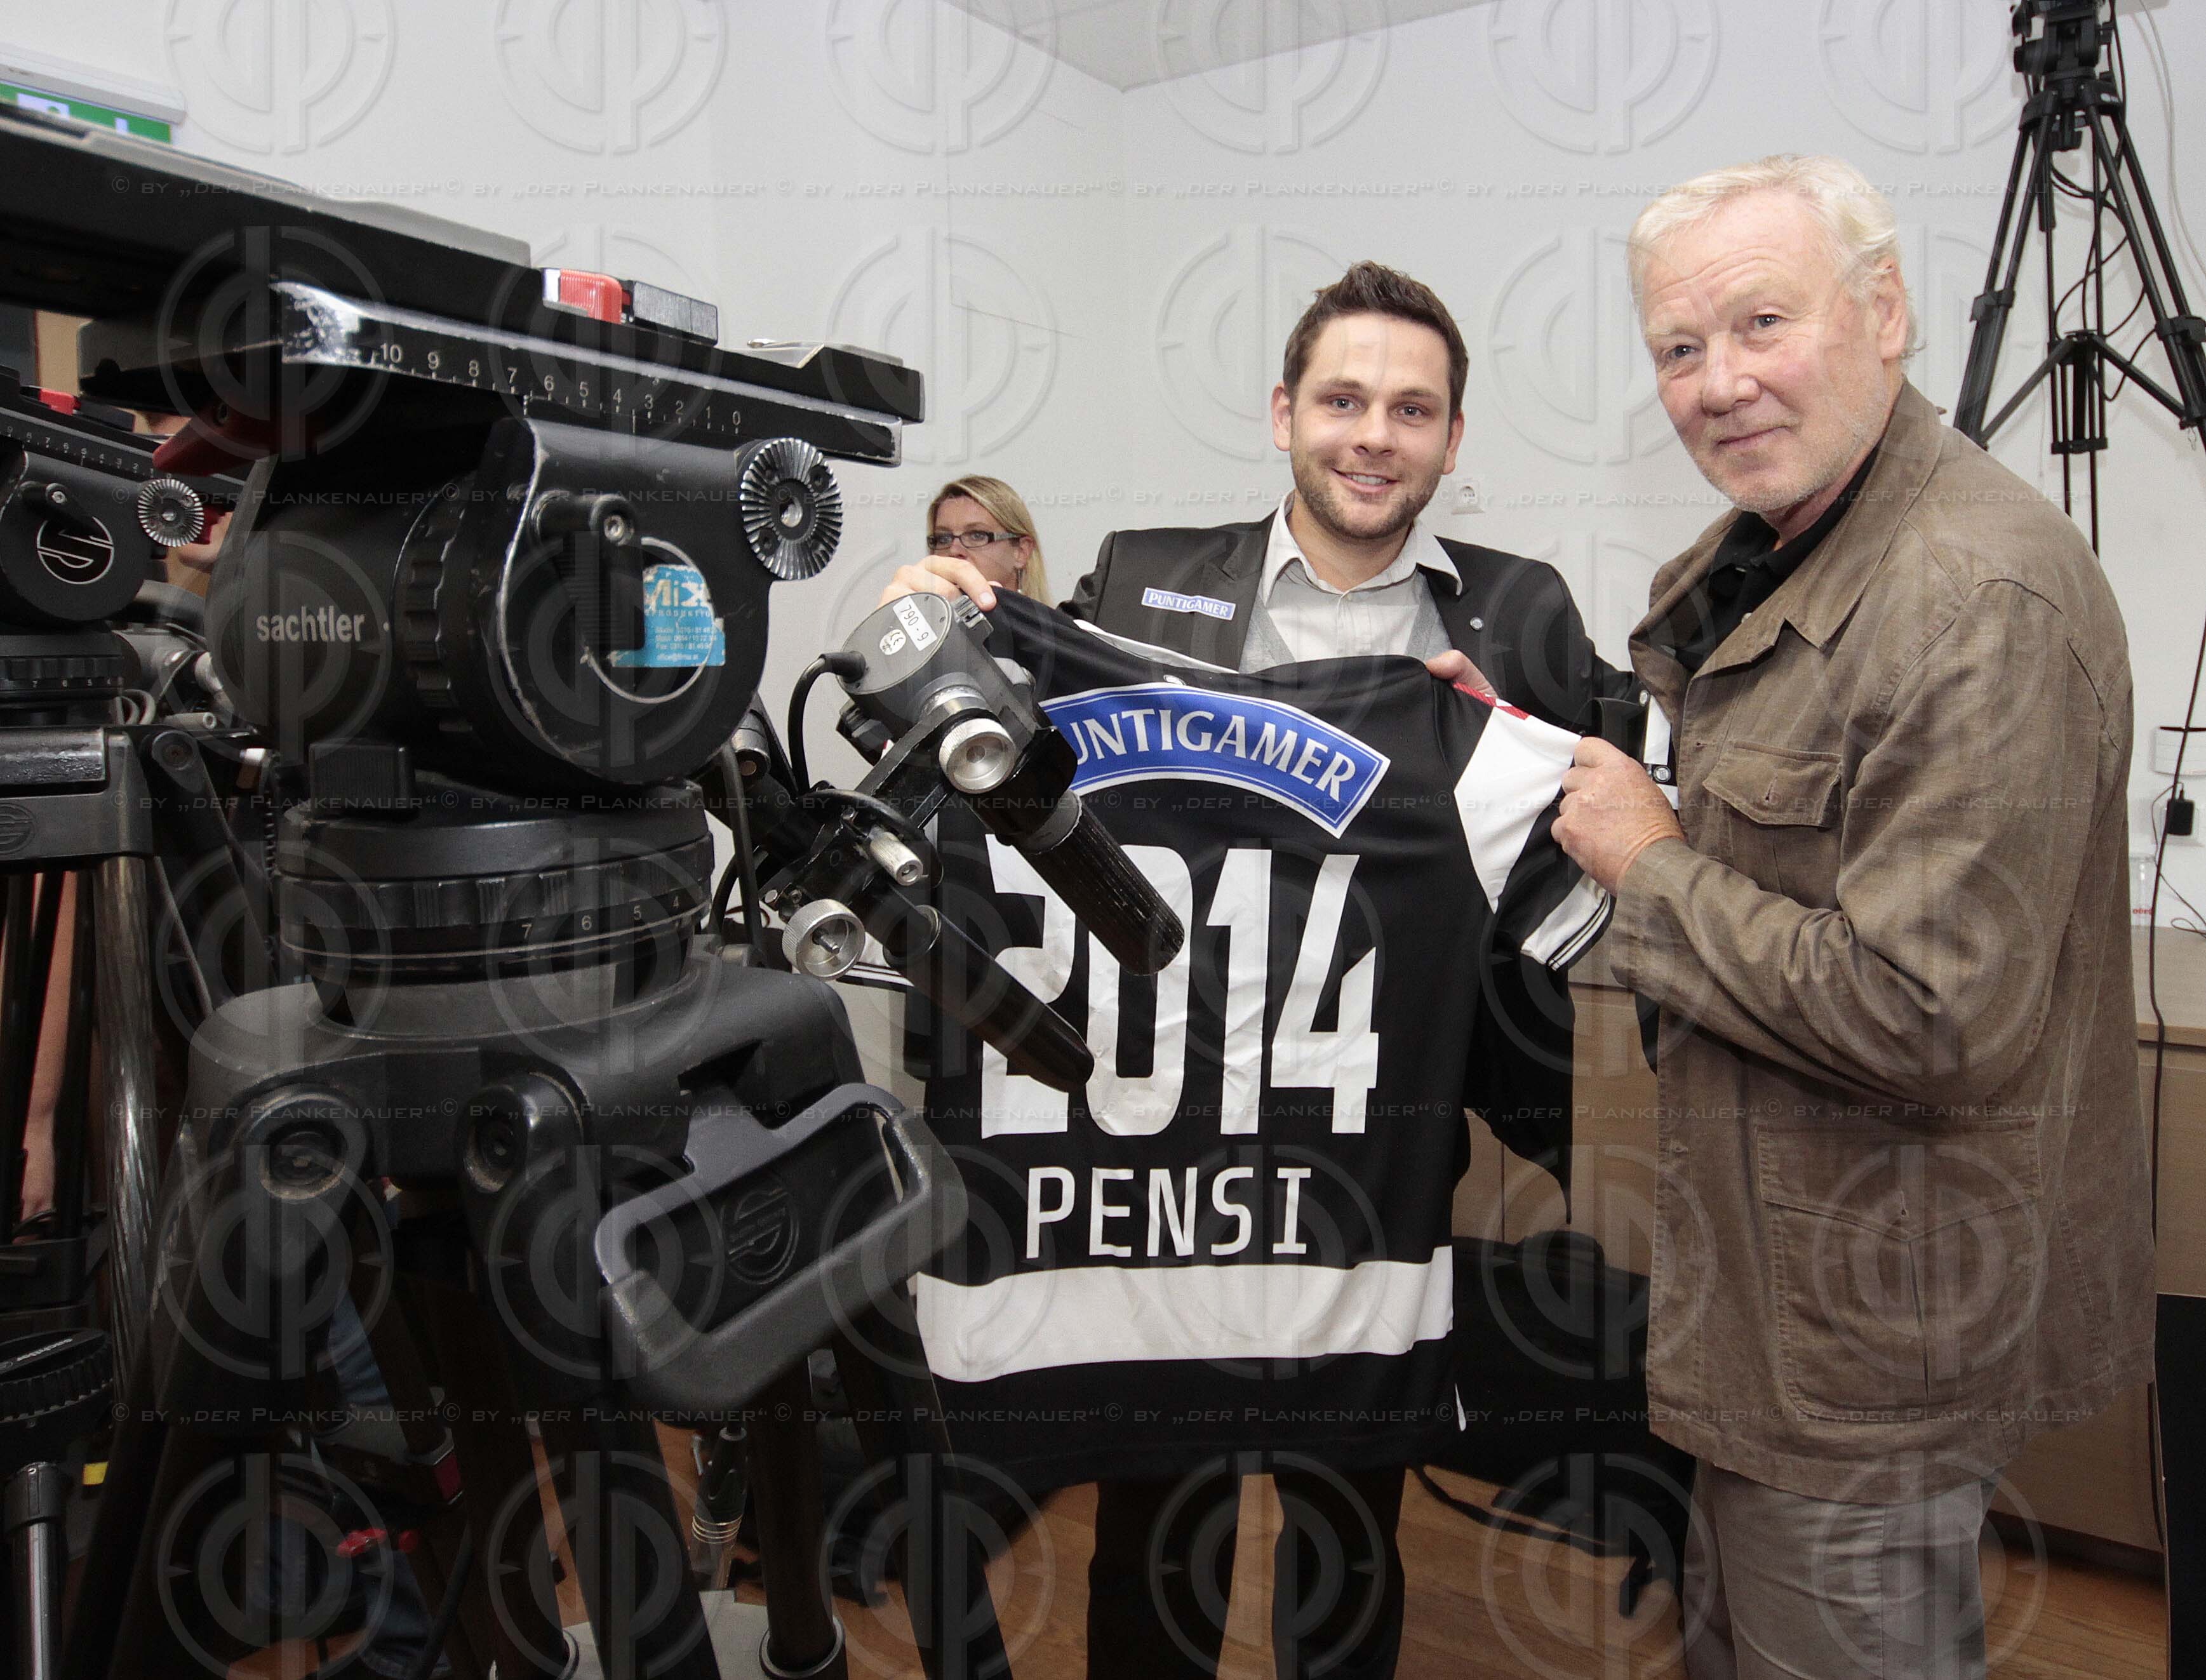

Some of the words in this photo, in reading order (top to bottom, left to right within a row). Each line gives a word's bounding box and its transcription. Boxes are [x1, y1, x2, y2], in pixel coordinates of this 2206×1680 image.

[380, 342, 403, 364] 10
[427, 350, 440, 370] 9
[468, 359, 480, 377] 8
[507, 367, 518, 383] 7
[544, 375, 555, 392] 6
[579, 382, 589, 397] 5
[613, 388, 622, 403] 4
[645, 394, 654, 410] 3
[675, 400, 685, 414] 2
[705, 406, 711, 418] 1
[732, 411, 741, 425] 0
[256, 605, 364, 643] sachtler
[1148, 592, 1229, 617] PUNTIGAMER
[1070, 708, 1356, 802] UNTIGAMER
[521, 923, 533, 939] 7
[582, 915, 592, 931] 6
[633, 904, 642, 921] 5
[672, 895, 679, 909] 4
[981, 834, 1379, 1140] 2014
[1026, 1166, 1311, 1258] PENSI
